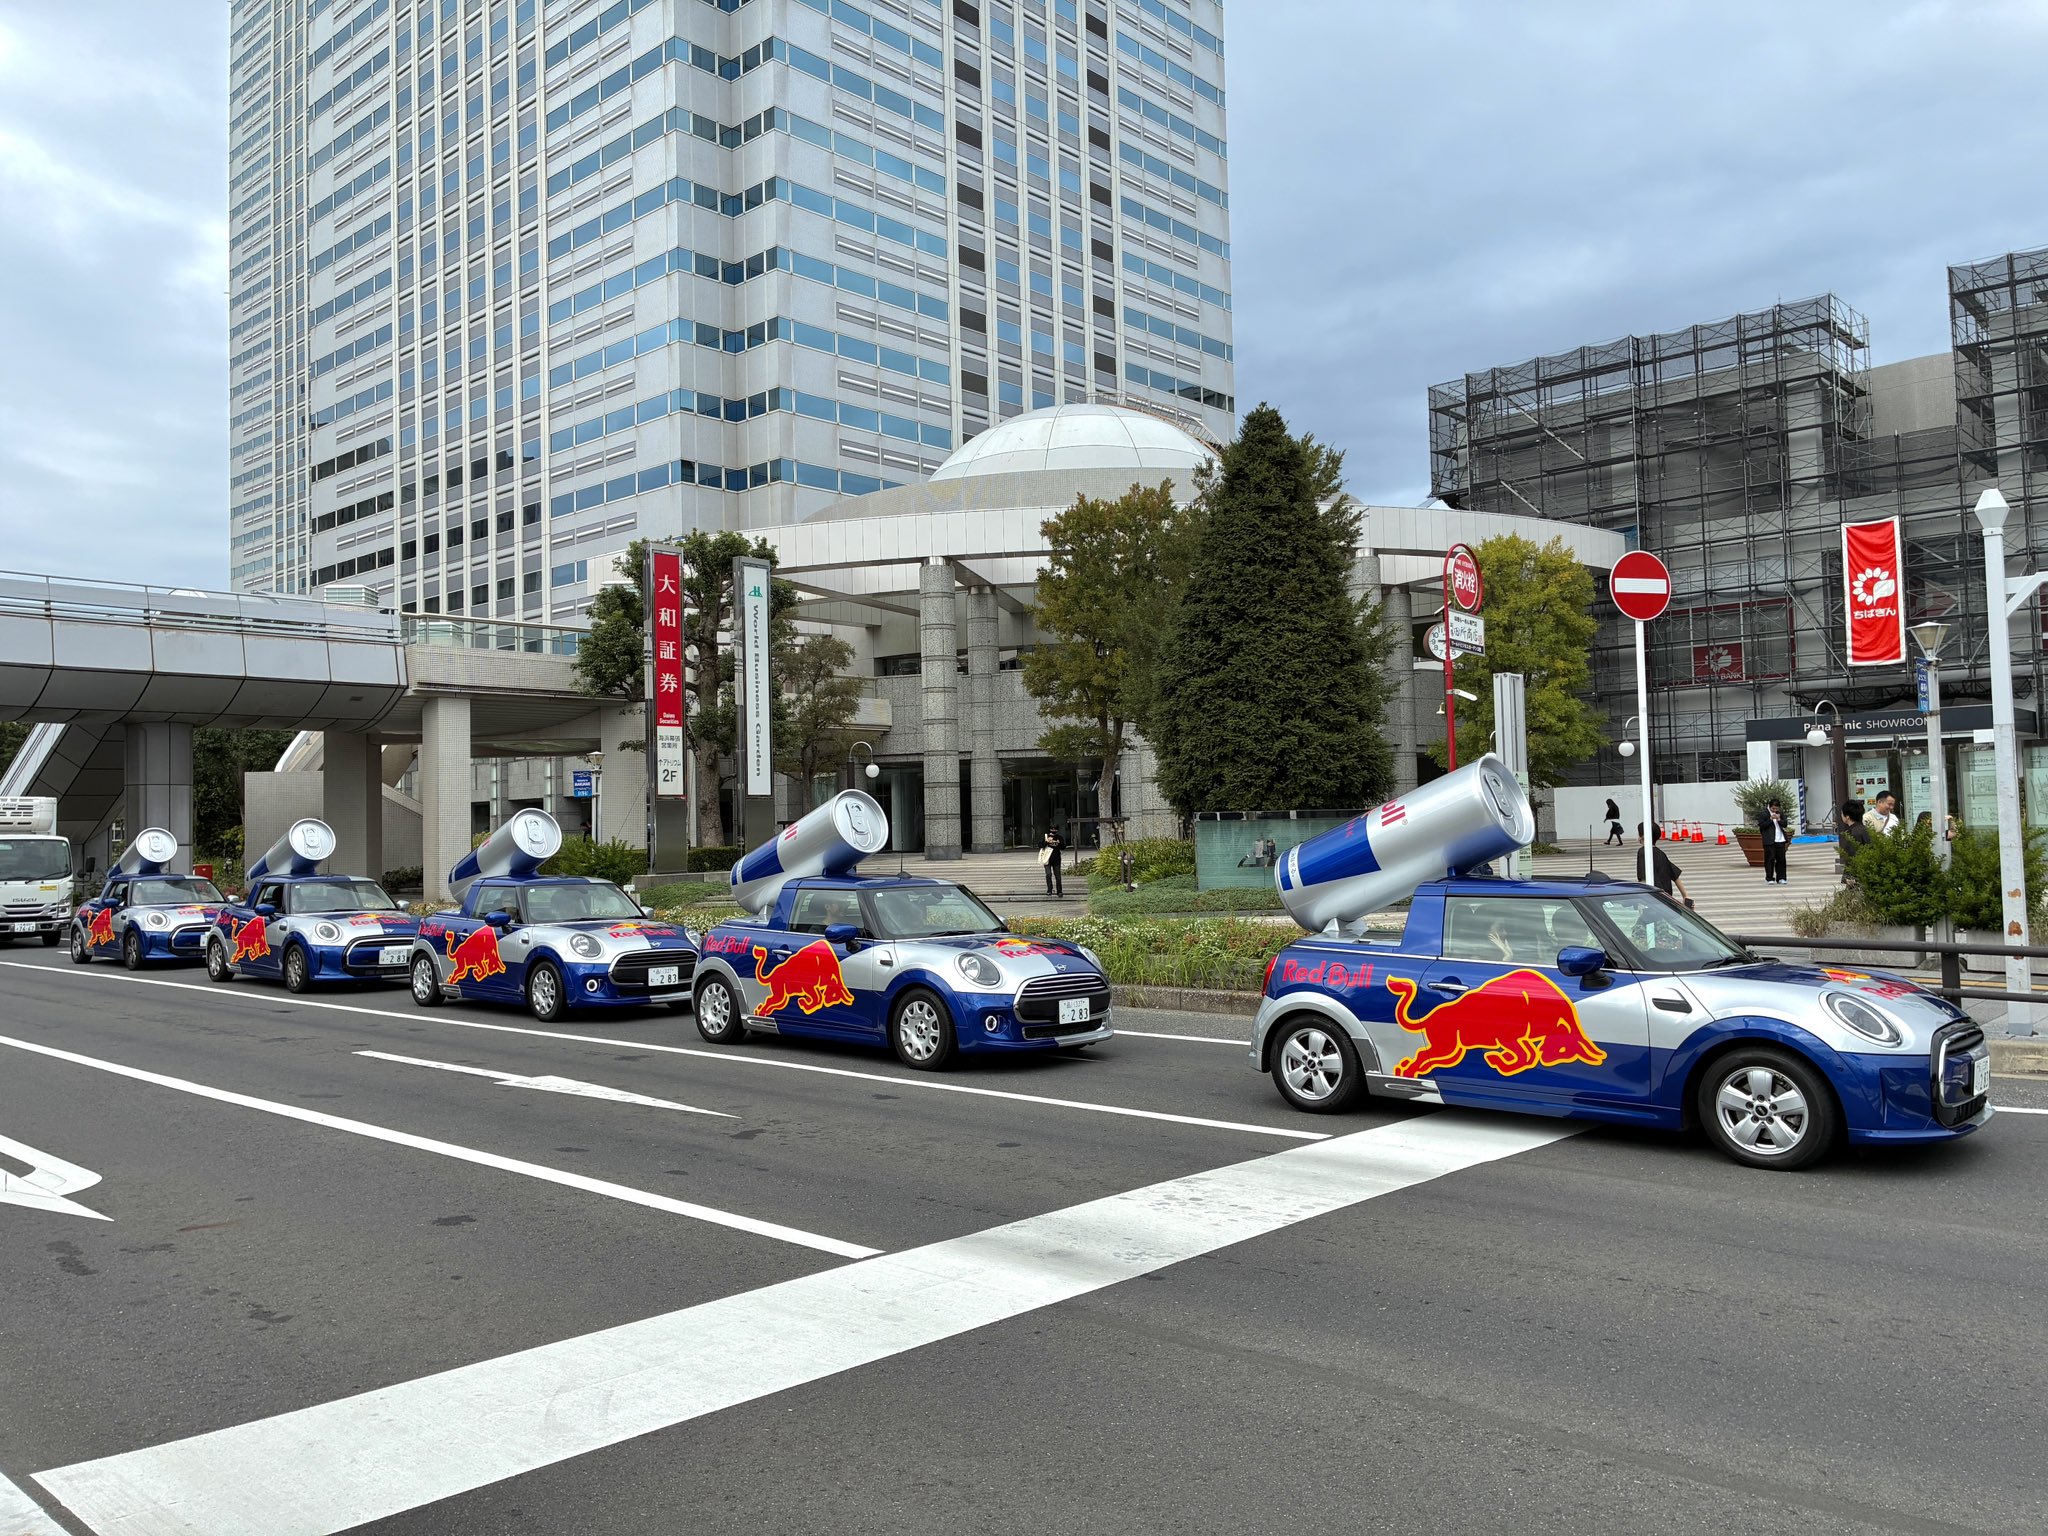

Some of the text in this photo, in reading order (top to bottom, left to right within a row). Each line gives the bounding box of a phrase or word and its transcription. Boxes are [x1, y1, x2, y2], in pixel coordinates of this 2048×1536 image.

[1454, 568, 1476, 594] 消火栓
[1854, 607, 1896, 620] ちばぎん
[658, 574, 678, 693] 大和証券
[662, 769, 677, 782] 2F
[349, 918, 380, 927] Red
[609, 928, 676, 938] Red Bull
[705, 934, 751, 954] Red Bull
[1000, 946, 1075, 958] Red Bull
[390, 955, 406, 963] 283
[660, 974, 677, 984] 283
[1282, 960, 1374, 988] Red Bull
[1071, 1008, 1088, 1021] 283
